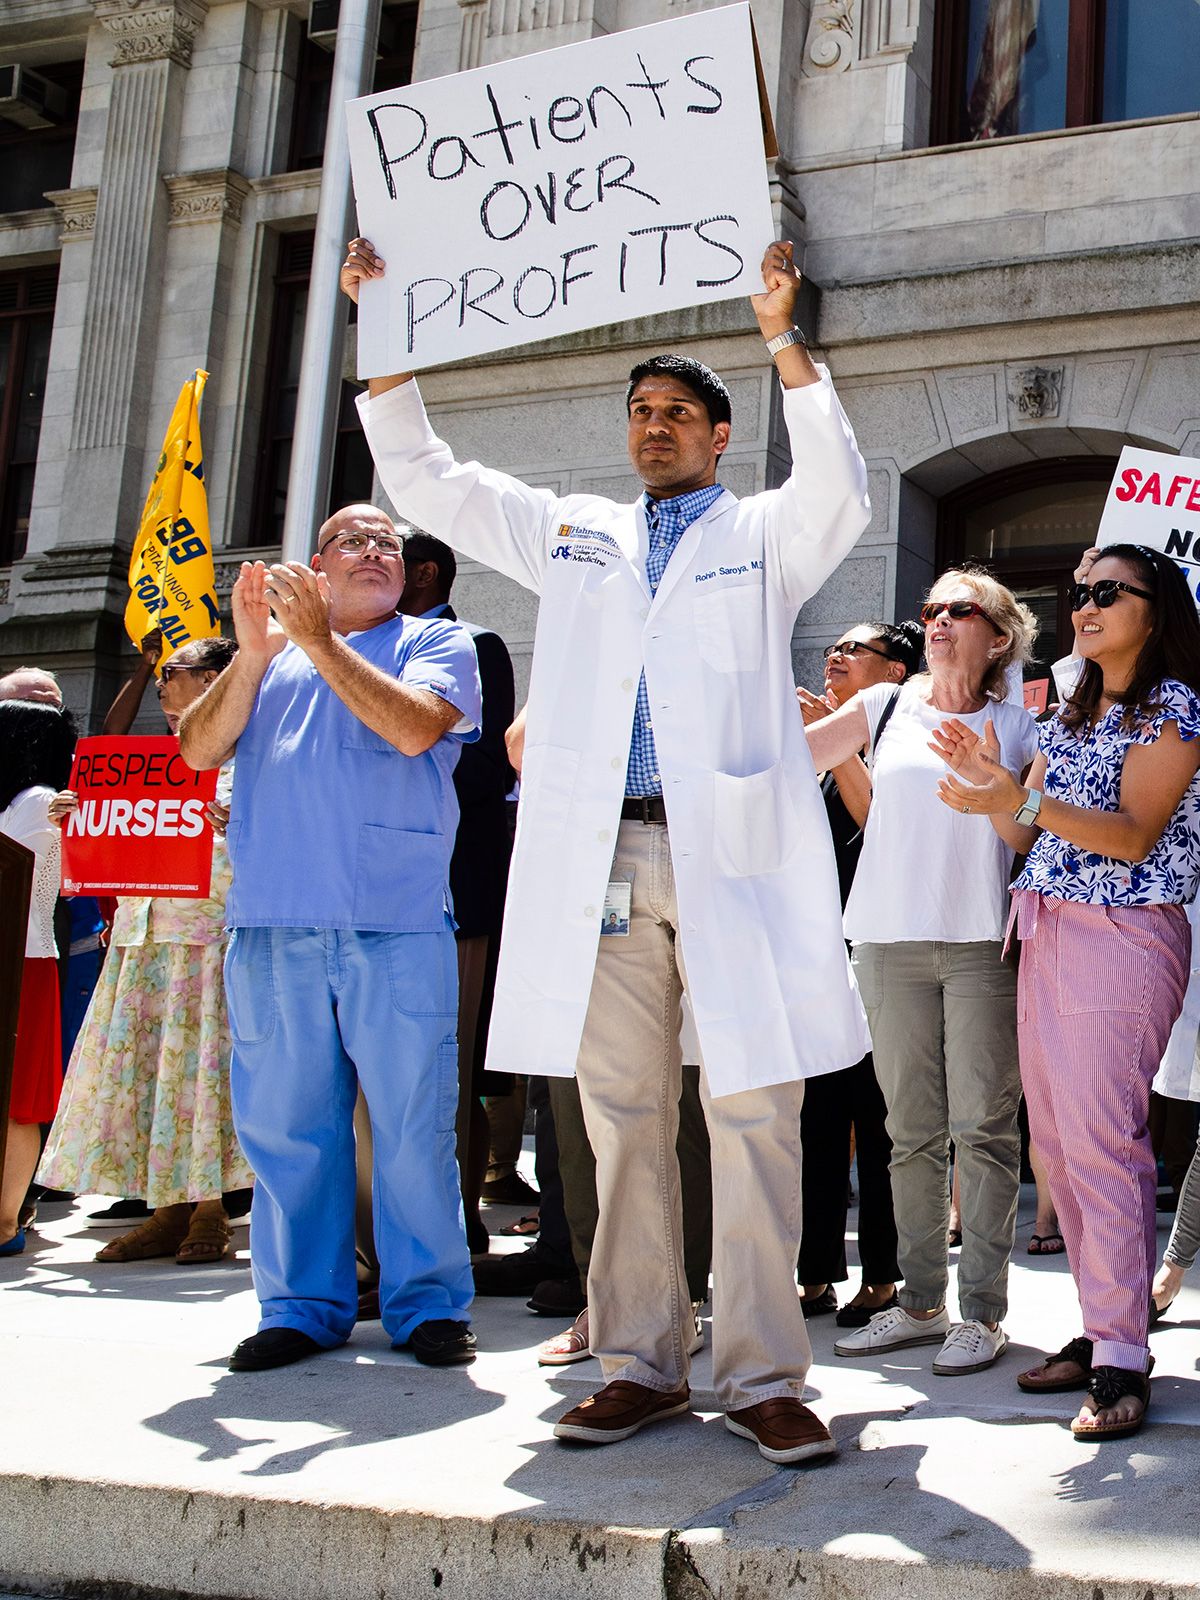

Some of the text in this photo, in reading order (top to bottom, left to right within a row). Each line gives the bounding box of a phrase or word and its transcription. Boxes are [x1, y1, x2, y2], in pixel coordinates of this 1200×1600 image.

[367, 53, 723, 200] Patients
[480, 154, 661, 241] OVER
[404, 215, 744, 353] PROFITS
[156, 514, 208, 566] 99
[571, 526, 617, 544] Hahneman
[572, 554, 606, 567] Medicine
[695, 571, 716, 582] Rohin
[719, 565, 749, 576] Saroya,
[155, 614, 191, 649] ALL
[66, 798, 205, 837] NURSES
